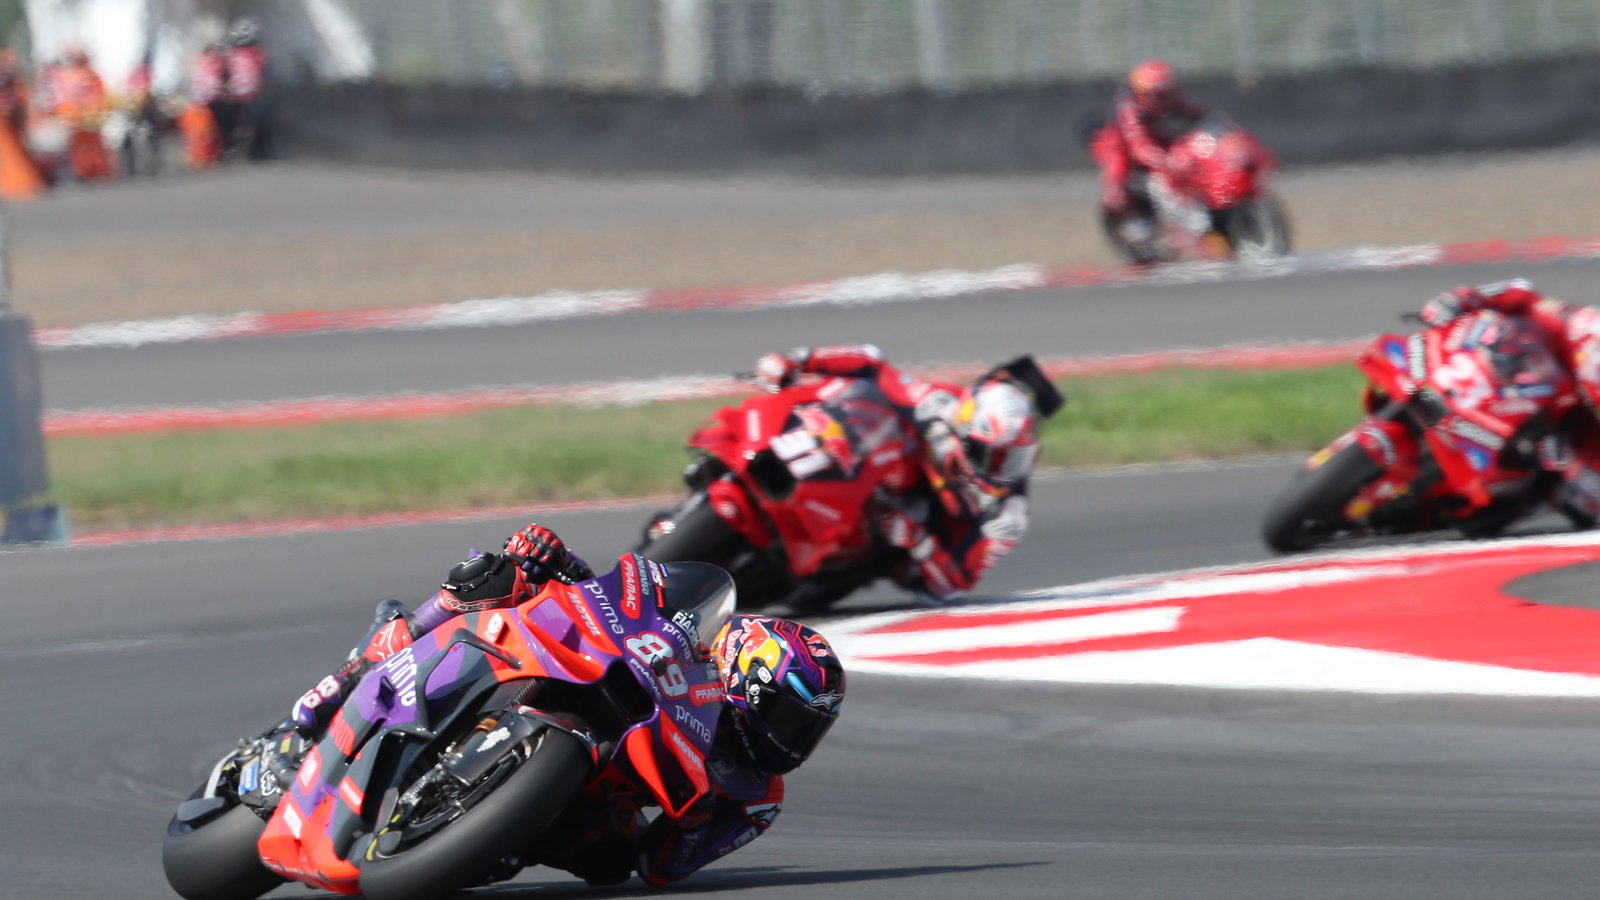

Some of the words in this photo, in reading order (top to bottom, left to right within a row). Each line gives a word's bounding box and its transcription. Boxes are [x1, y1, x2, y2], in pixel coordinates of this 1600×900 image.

[584, 580, 624, 635] prima
[623, 560, 637, 610] PRAMAC
[567, 591, 601, 636] MOTUL
[662, 622, 692, 660] prima
[624, 632, 689, 698] 89
[630, 658, 662, 701] PRAMAC
[676, 705, 712, 743] prima
